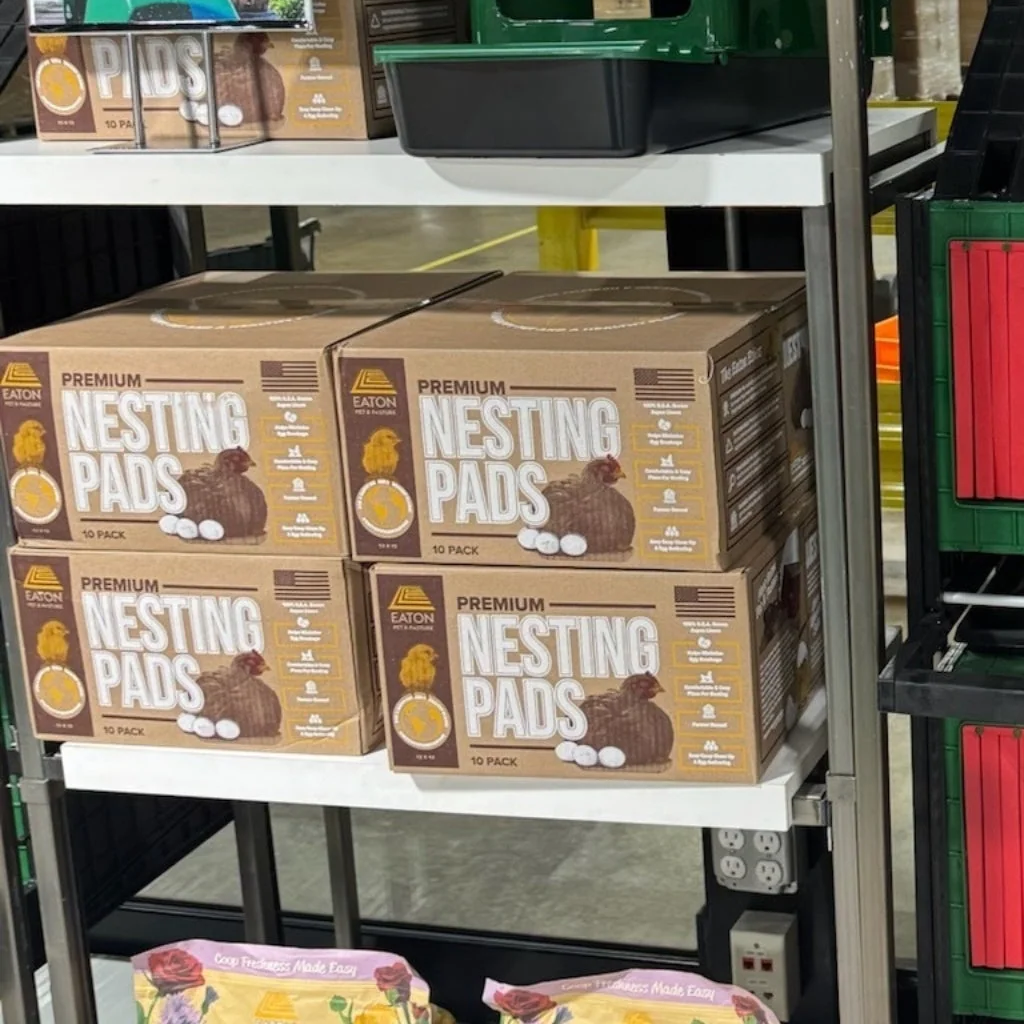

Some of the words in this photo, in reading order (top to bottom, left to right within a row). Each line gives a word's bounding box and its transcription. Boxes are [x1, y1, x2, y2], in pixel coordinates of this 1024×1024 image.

[105, 120, 117, 129] 10
[62, 373, 141, 388] PREMIUM
[417, 380, 506, 395] PREMIUM
[2, 388, 42, 401] EATON
[353, 396, 397, 408] EATON
[61, 390, 250, 453] NESTING
[419, 396, 622, 461] NESTING
[69, 452, 188, 515] PADS
[424, 459, 550, 526] PADS
[82, 530, 94, 539] 10
[97, 530, 126, 540] PACK
[432, 545, 445, 555] 10
[448, 546, 479, 556] PACK
[81, 577, 159, 593] PREMIUM
[25, 591, 64, 603] EATON
[457, 597, 545, 612] PREMIUM
[81, 591, 264, 655] NESTING
[391, 612, 434, 624] EATON
[457, 613, 660, 678] NESTING
[90, 650, 205, 714] PADS
[462, 676, 588, 741] PADS
[104, 726, 117, 735] 10
[119, 727, 145, 736] PACK
[471, 757, 483, 766] 10
[486, 757, 517, 767] PACK
[214, 952, 239, 967] Coop
[241, 956, 291, 972] Freshness
[293, 959, 326, 975] Made
[329, 961, 358, 976] Easy
[651, 980, 684, 997] Made
[687, 983, 716, 1000] Easy
